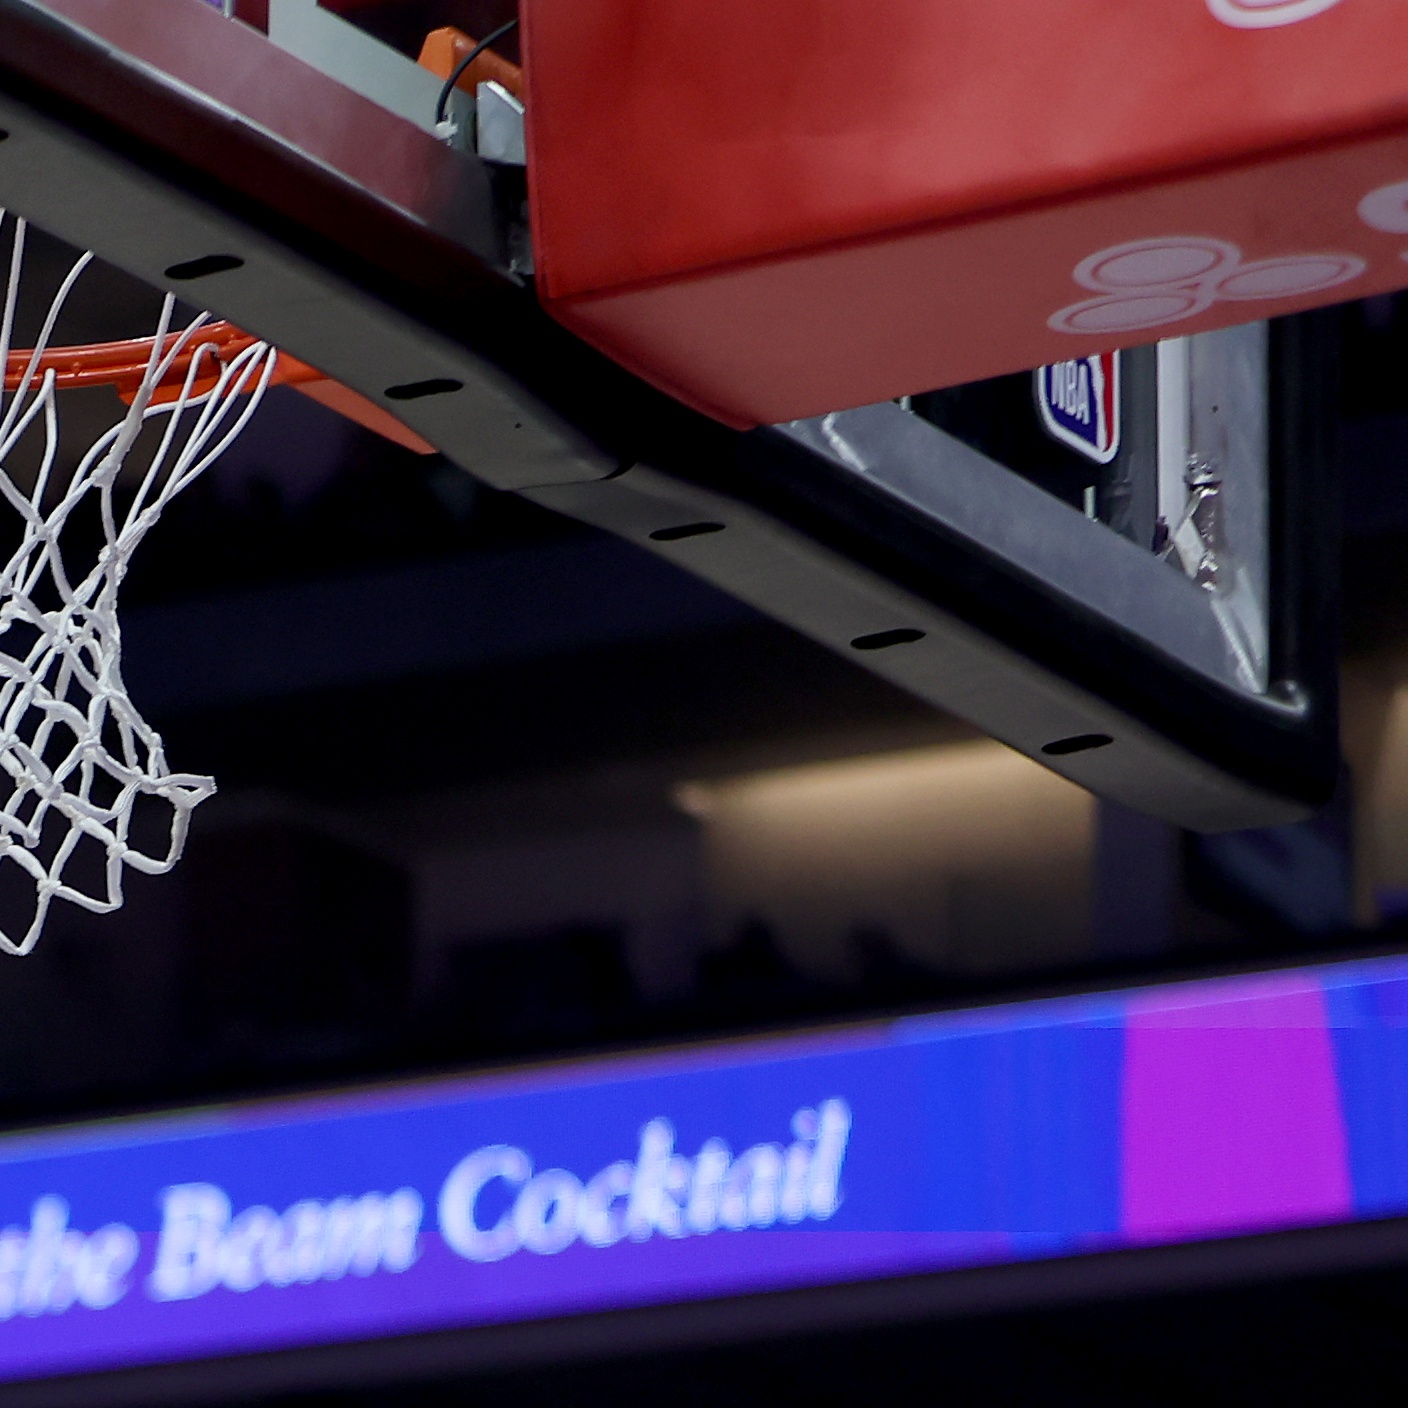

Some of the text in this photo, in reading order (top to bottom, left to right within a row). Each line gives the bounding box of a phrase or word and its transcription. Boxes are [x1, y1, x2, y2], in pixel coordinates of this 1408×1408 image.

[1051, 359, 1091, 425] NBA
[147, 1180, 424, 1303] Beam
[438, 1096, 853, 1263] Cocktail
